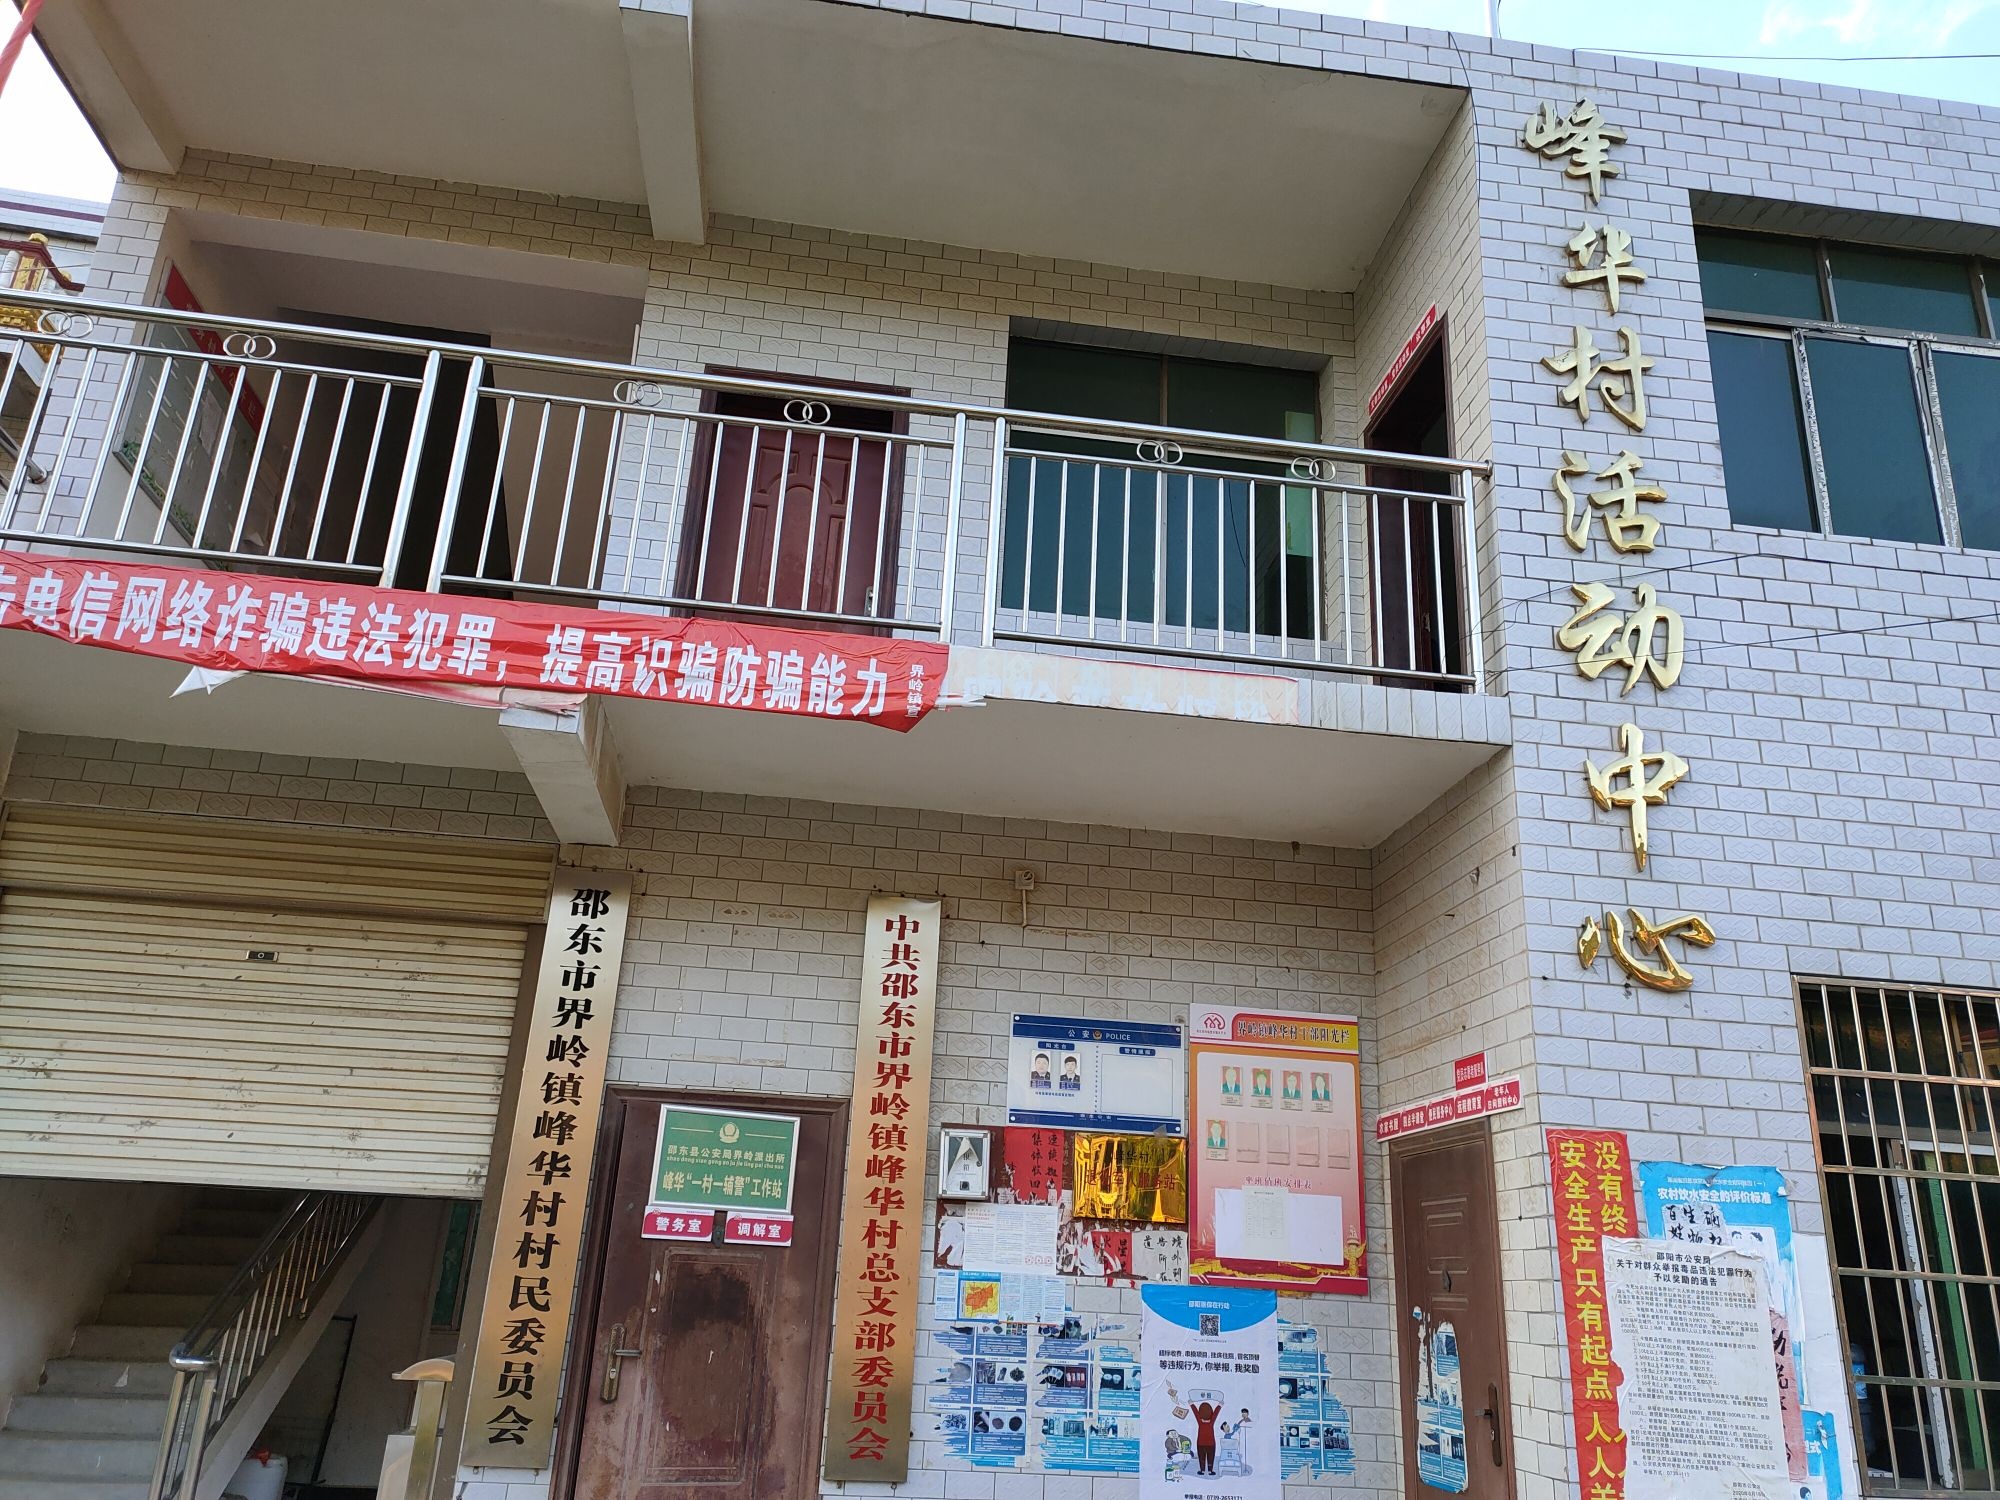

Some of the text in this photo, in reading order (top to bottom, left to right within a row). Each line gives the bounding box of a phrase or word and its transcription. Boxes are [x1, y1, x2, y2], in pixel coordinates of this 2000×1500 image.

[1524, 97, 1716, 992] 峰华村活动中心
[905, 664, 924, 717] 界岭镇宣
[1105, 1033, 1131, 1041] POLICE
[668, 1145, 785, 1164] 邵东县公安局界岭派出所
[485, 888, 612, 1447] 邵东市界岭镇峰华村村民委员会
[846, 914, 921, 1461] 中共邵东市界岭镇峰华村总支部委员会
[1593, 1139, 1629, 1235] 没有终
[1657, 1187, 1772, 1205] 农村饮水安全的评价标准
[656, 1216, 702, 1233] 警务室
[737, 1222, 782, 1239] 调解室
[1616, 1258, 1753, 1278] 关于对群众举报毒品违法犯罪行为
[1656, 1252, 1711, 1265] 邵阳市公安局
[1653, 1273, 1718, 1287] 予以奖励的通告
